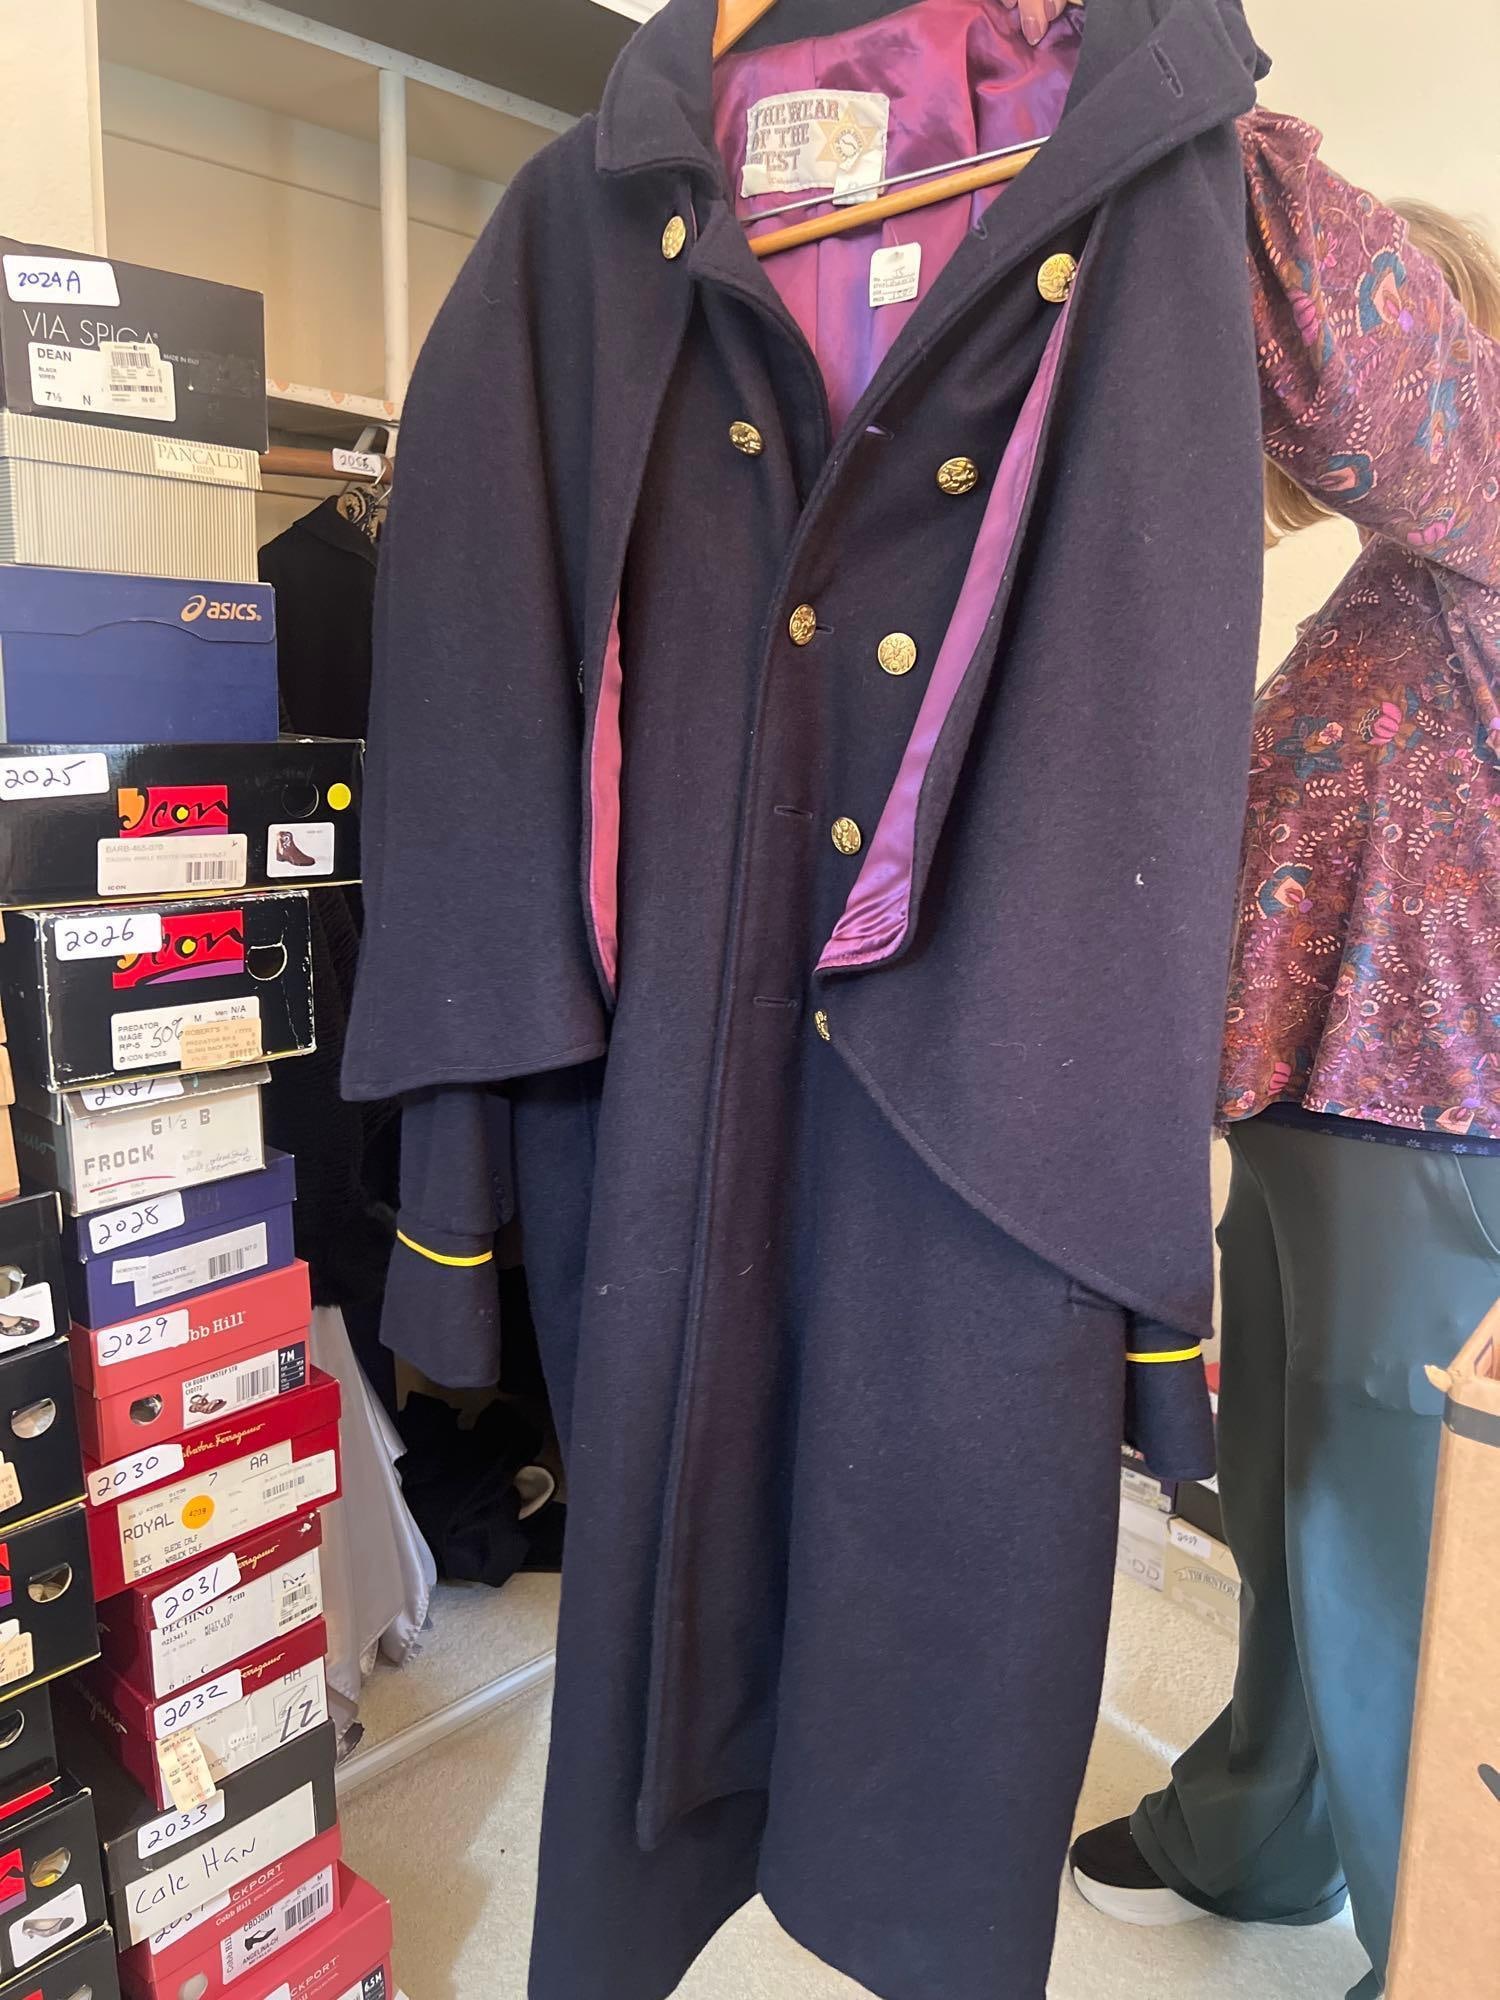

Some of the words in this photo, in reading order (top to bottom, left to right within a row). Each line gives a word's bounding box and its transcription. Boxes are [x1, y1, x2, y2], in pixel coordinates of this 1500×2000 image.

[787, 99, 840, 122] WEAR
[774, 122, 810, 148] THE
[22, 309, 70, 343] VIA
[36, 347, 72, 362] DEAN
[82, 395, 92, 406] N
[157, 443, 243, 470] PANCALDI
[206, 600, 258, 621] asics
[5, 760, 86, 789] 2025
[64, 918, 134, 952] 2026
[118, 1021, 159, 1033] PREDATOR
[118, 1032, 143, 1042] IMAGE
[119, 1043, 141, 1051] RP-5
[145, 1050, 168, 1059] SHOES
[200, 1108, 211, 1126] B
[84, 1144, 154, 1176] FROCK
[98, 1204, 160, 1245] 2028
[152, 1265, 187, 1280] NICCOLETTE
[102, 1317, 168, 1359] 2029
[190, 1326, 210, 1342] bb
[213, 1311, 246, 1333] Hill
[210, 1368, 228, 1380] INSTEP
[183, 1441, 215, 1459] alvatore
[215, 1423, 266, 1447] Ferragamo
[97, 1456, 160, 1498] 2030
[208, 1472, 218, 1487] 7
[250, 1453, 269, 1470] AA
[123, 1512, 175, 1544] ROYAL
[133, 1554, 152, 1568] BLACK
[164, 1541, 182, 1554] SUEDE
[184, 1534, 198, 1546] CALF
[236, 1544, 280, 1569] erragamo
[134, 1565, 153, 1578] BLACK
[164, 1567, 219, 1619] 2031
[162, 1605, 214, 1636] PECHINO
[227, 1590, 246, 1605] 7cm
[201, 1663, 209, 1674] C
[164, 1685, 228, 1728] 2032
[147, 1804, 208, 1849] 2033
[232, 1862, 283, 1902] CKPORT
[215, 1909, 235, 1927] Cobb
[236, 1899, 252, 1915] Hill
[290, 1956, 338, 1997] CKPORT
